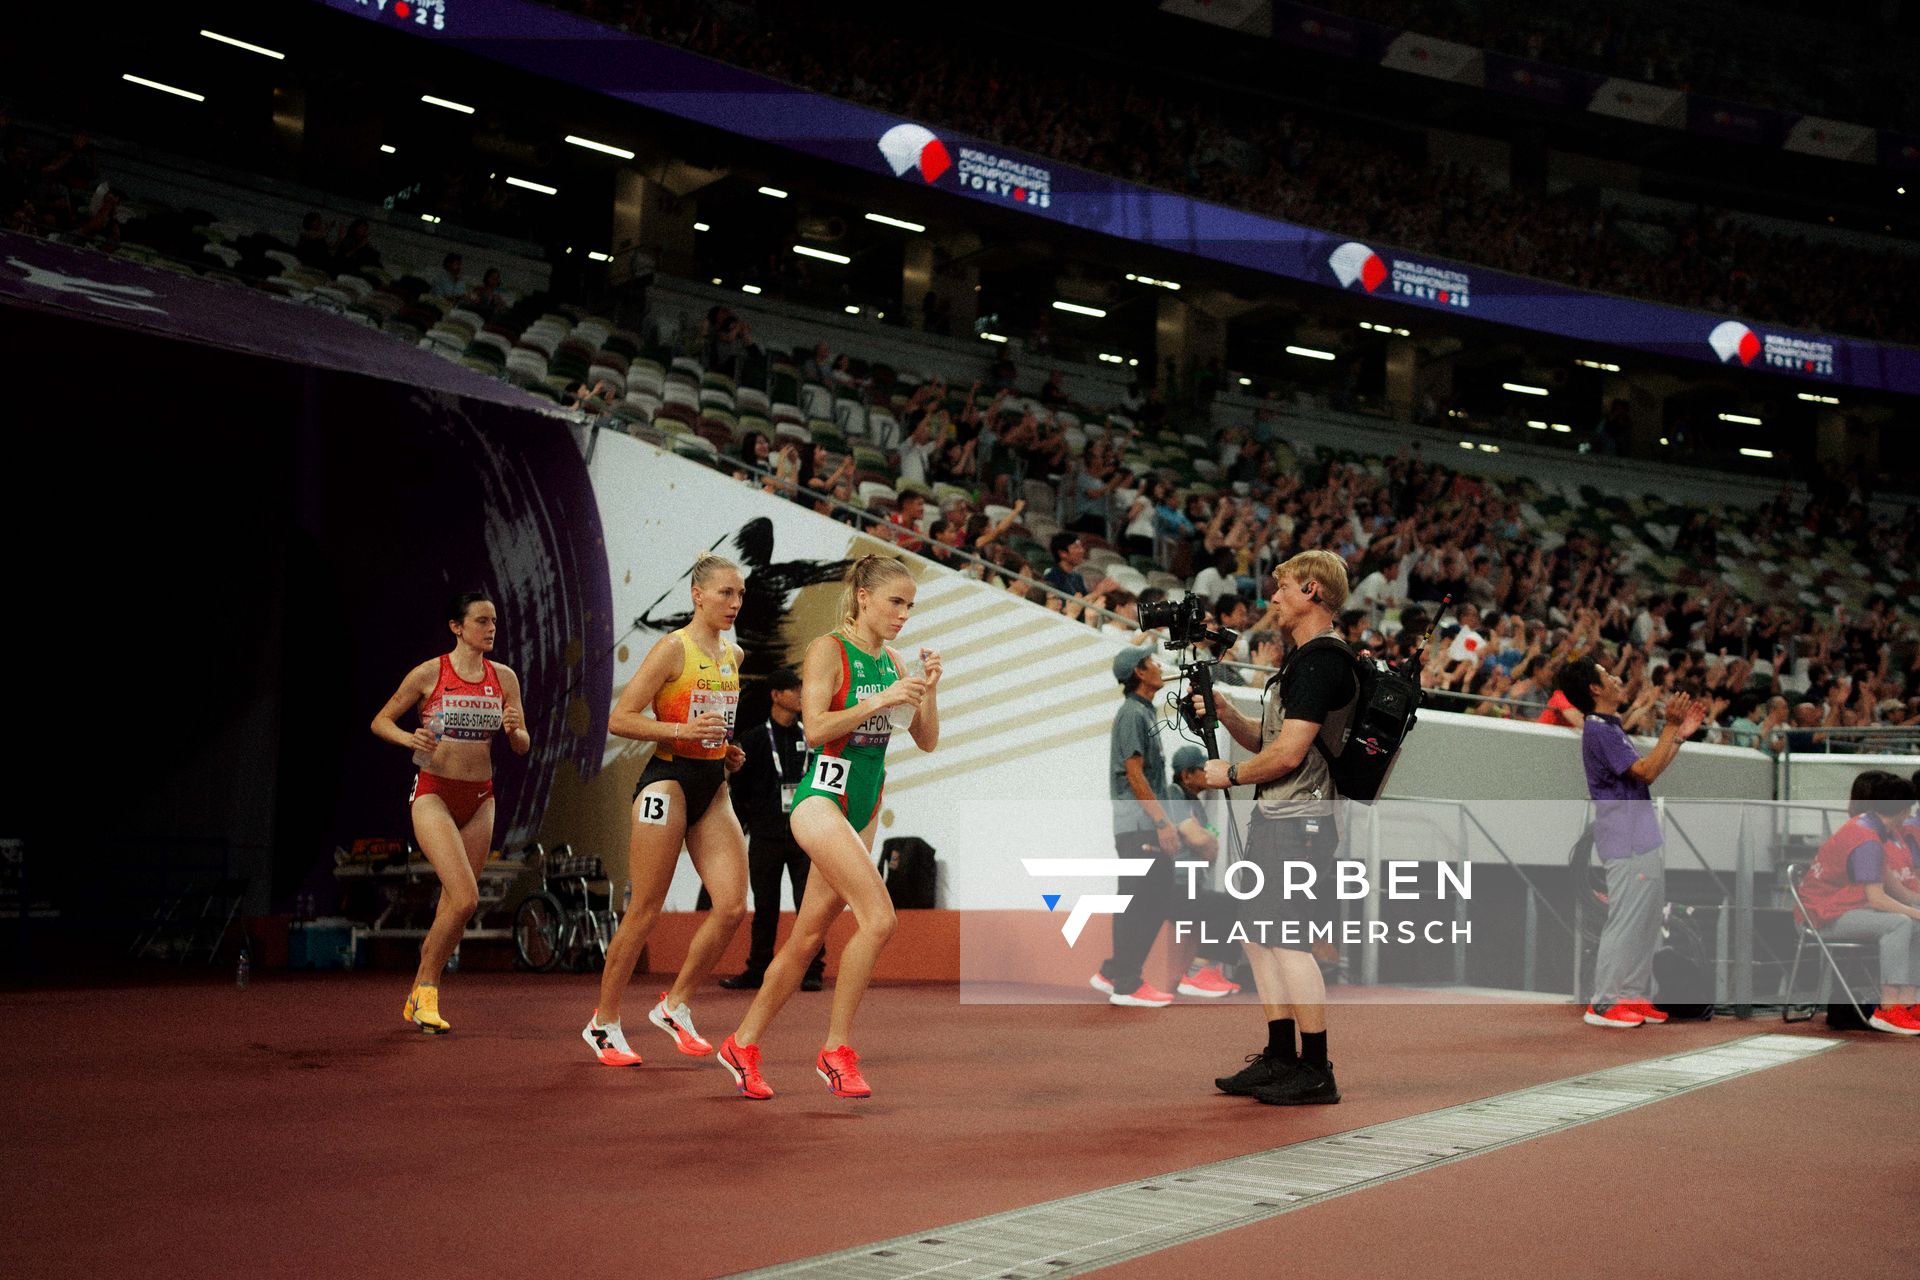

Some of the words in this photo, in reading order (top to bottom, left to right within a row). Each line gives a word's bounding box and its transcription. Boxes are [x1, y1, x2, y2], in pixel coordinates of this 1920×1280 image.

[445, 699, 500, 710] HONDA
[445, 712, 502, 729] DEBUES-STAFFORD
[819, 761, 845, 789] 12
[643, 797, 664, 820] 13
